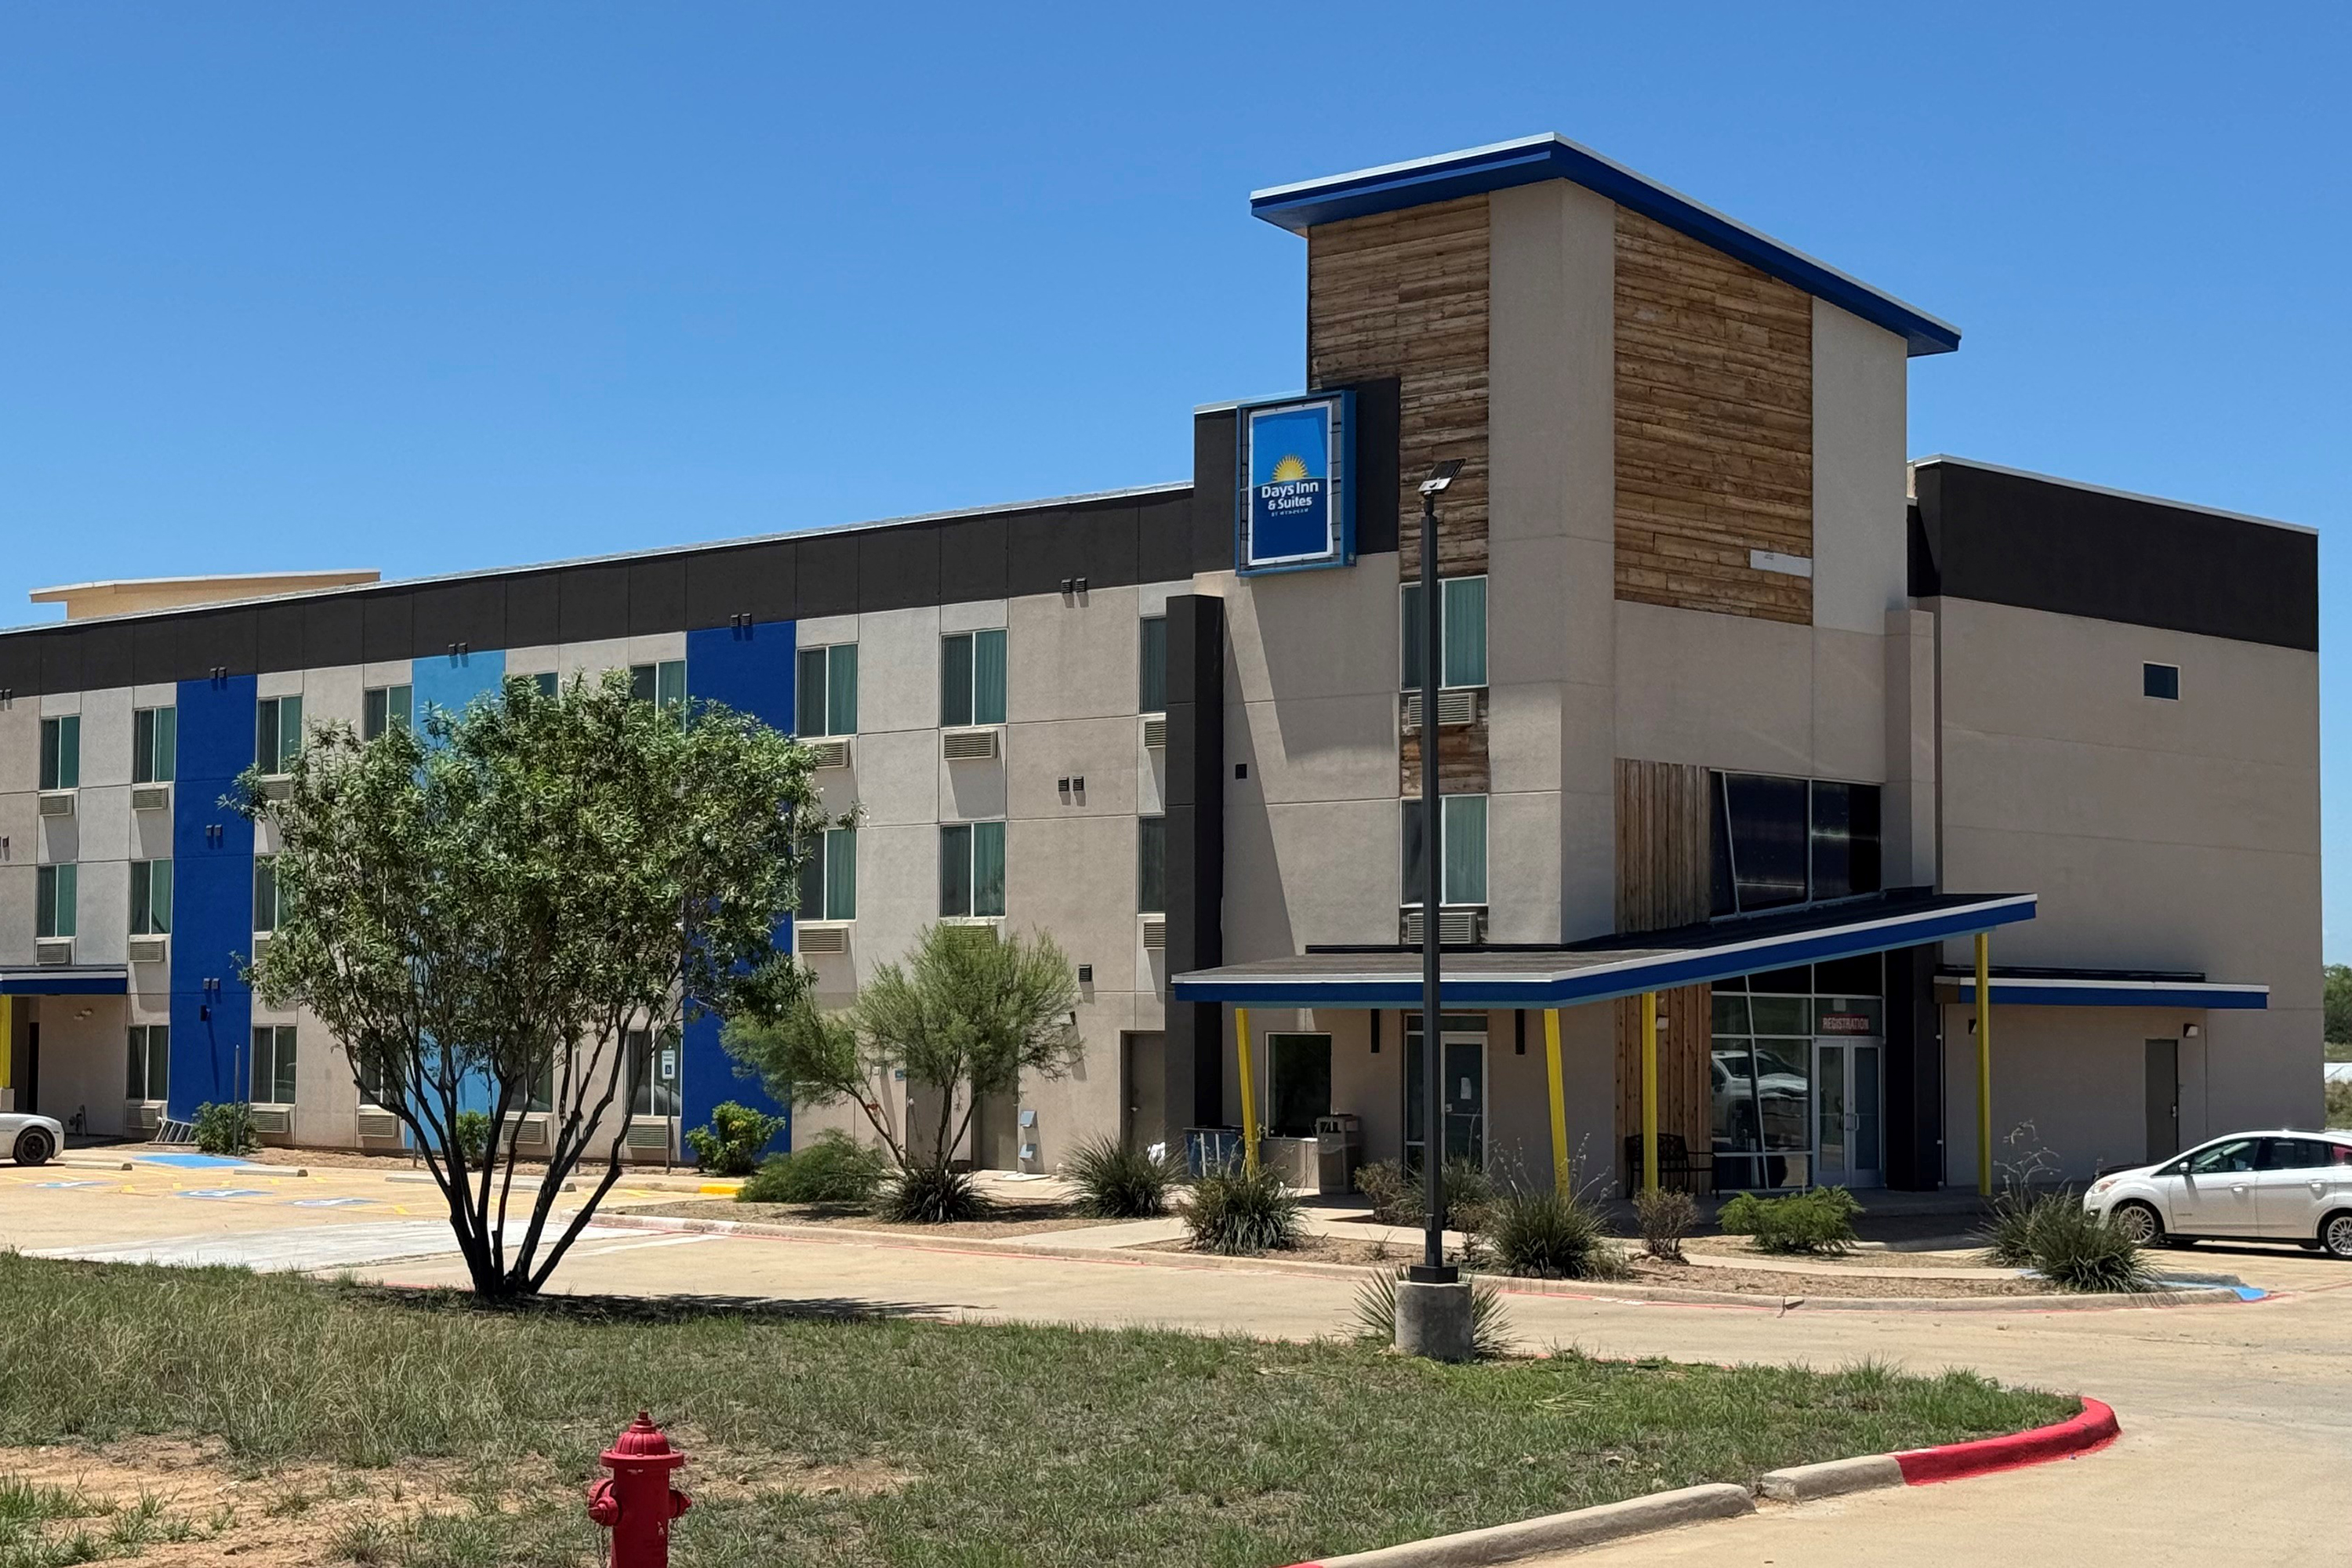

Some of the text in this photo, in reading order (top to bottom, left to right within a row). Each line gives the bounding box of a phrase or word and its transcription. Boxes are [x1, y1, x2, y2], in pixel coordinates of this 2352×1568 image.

[1261, 481, 1319, 498] Days Inn
[1268, 495, 1312, 510] & Suites
[1823, 1017, 1869, 1029] REGISTRATION
